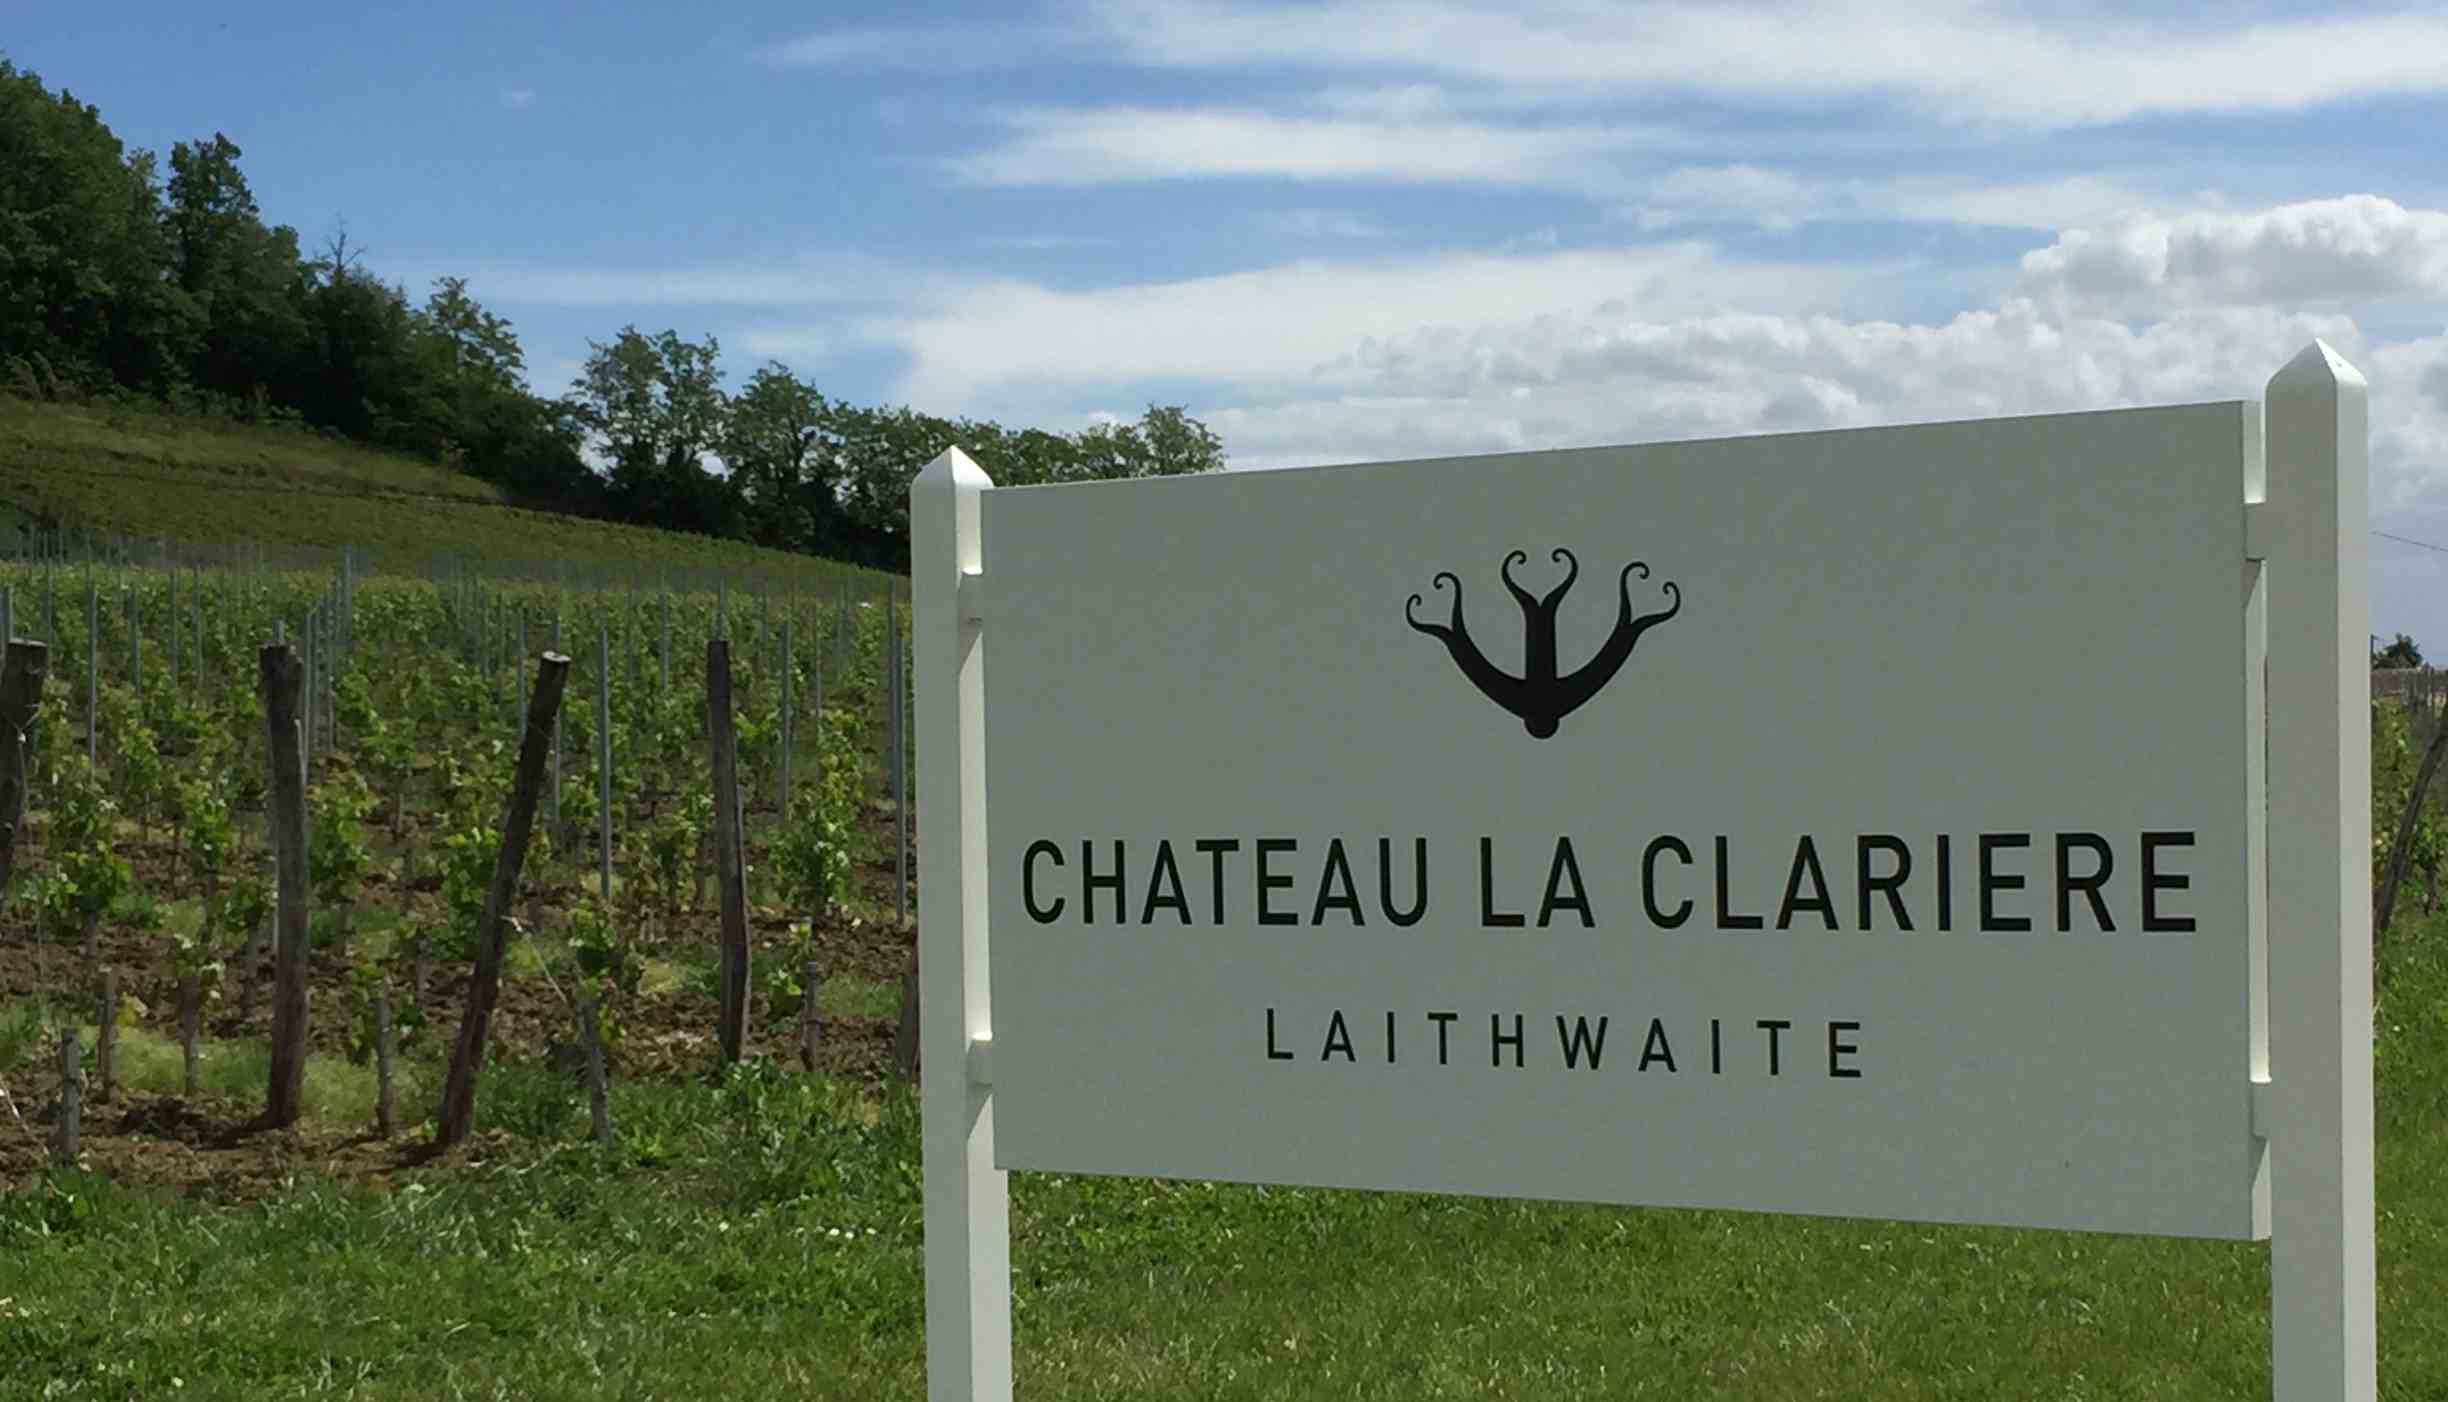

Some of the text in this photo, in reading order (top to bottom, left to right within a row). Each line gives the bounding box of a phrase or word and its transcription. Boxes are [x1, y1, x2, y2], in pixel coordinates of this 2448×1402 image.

[1022, 831, 2197, 933] CHATEAU LA CLARIERE
[1266, 1007, 1862, 1078] LAITHWAITE
